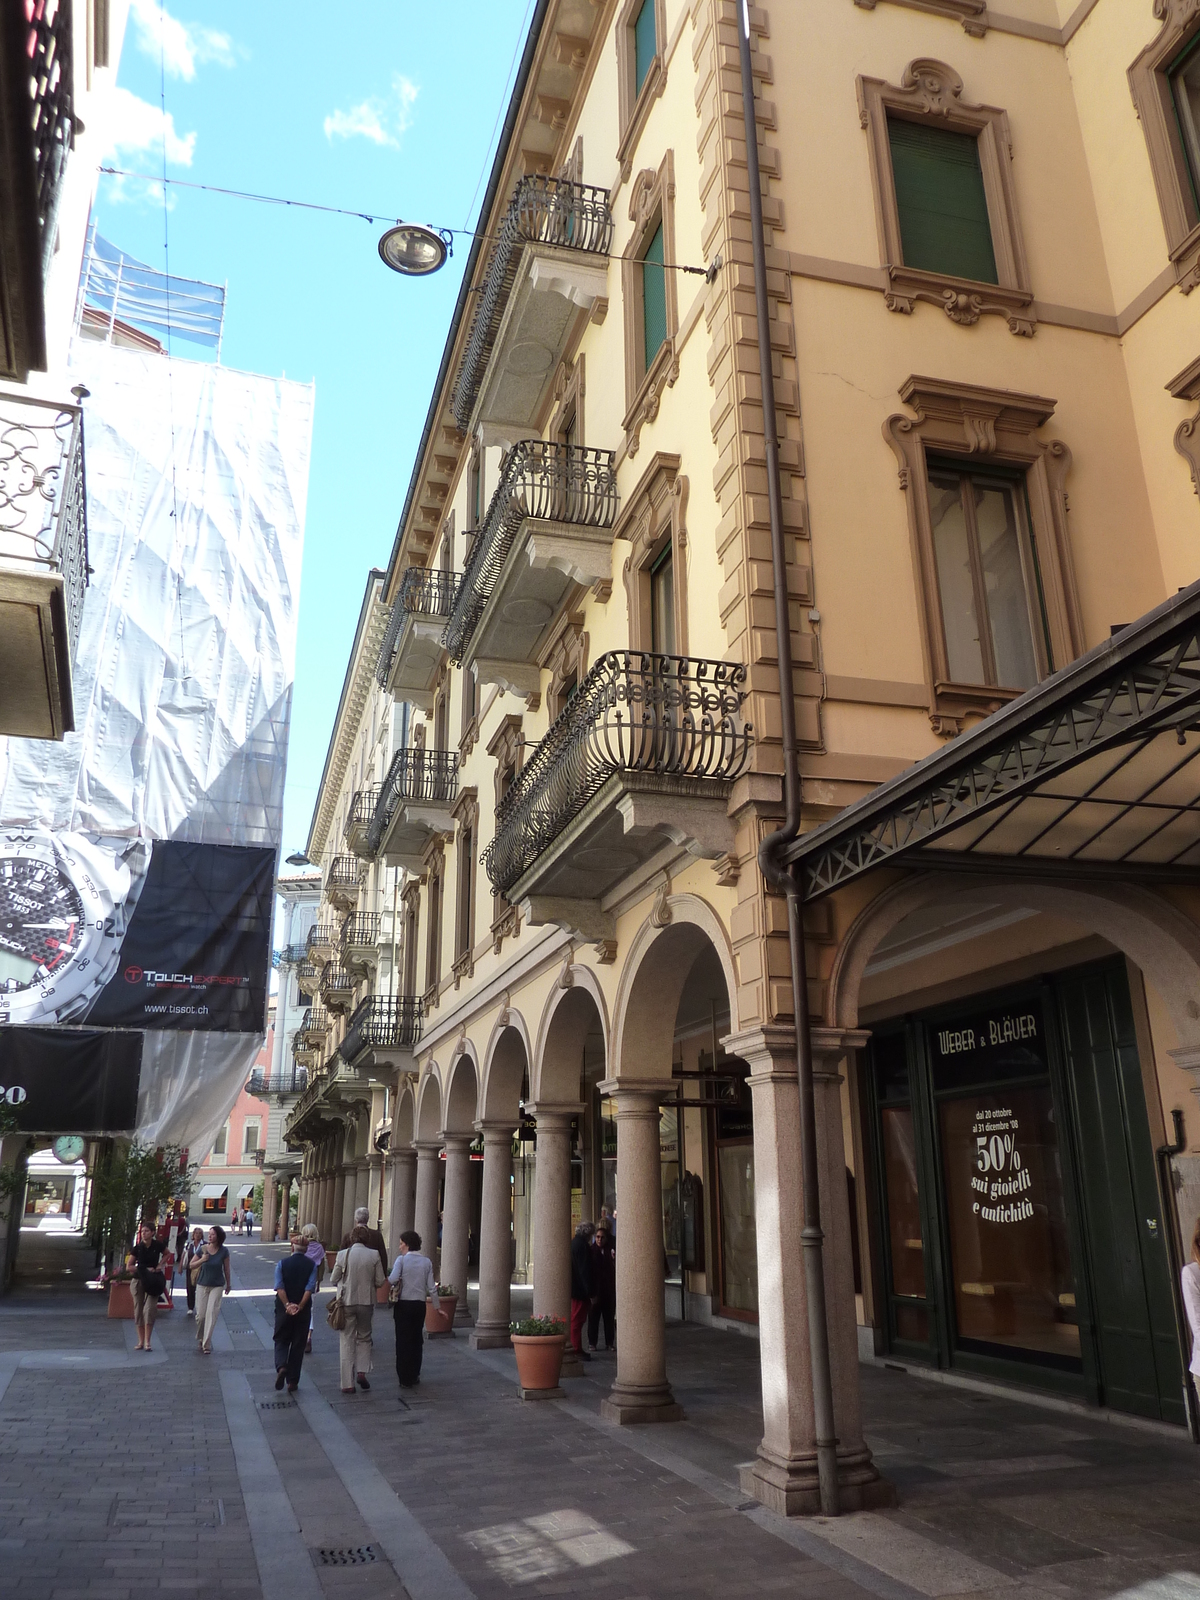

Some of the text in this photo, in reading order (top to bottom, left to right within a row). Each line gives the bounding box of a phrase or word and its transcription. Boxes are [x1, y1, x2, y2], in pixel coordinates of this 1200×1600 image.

[28, 859, 59, 876] METEO
[8, 891, 44, 910] TISSOT
[12, 903, 30, 914] 1853
[0, 934, 27, 951] OUCH
[143, 970, 193, 983] TOUCH
[194, 975, 243, 985] EXPERT
[144, 1005, 209, 1014] www.tissot.ch
[938, 1015, 1037, 1055] WEBER & BLÄUER
[976, 1108, 1012, 1120] dal 20 ottobre
[972, 1124, 977, 1133] al
[978, 1124, 984, 1132] 31
[985, 1121, 1009, 1132] dicembre
[976, 1133, 1021, 1172] 50%
[971, 1168, 1031, 1201] sui gioielli
[972, 1197, 1034, 1223] e antichità
